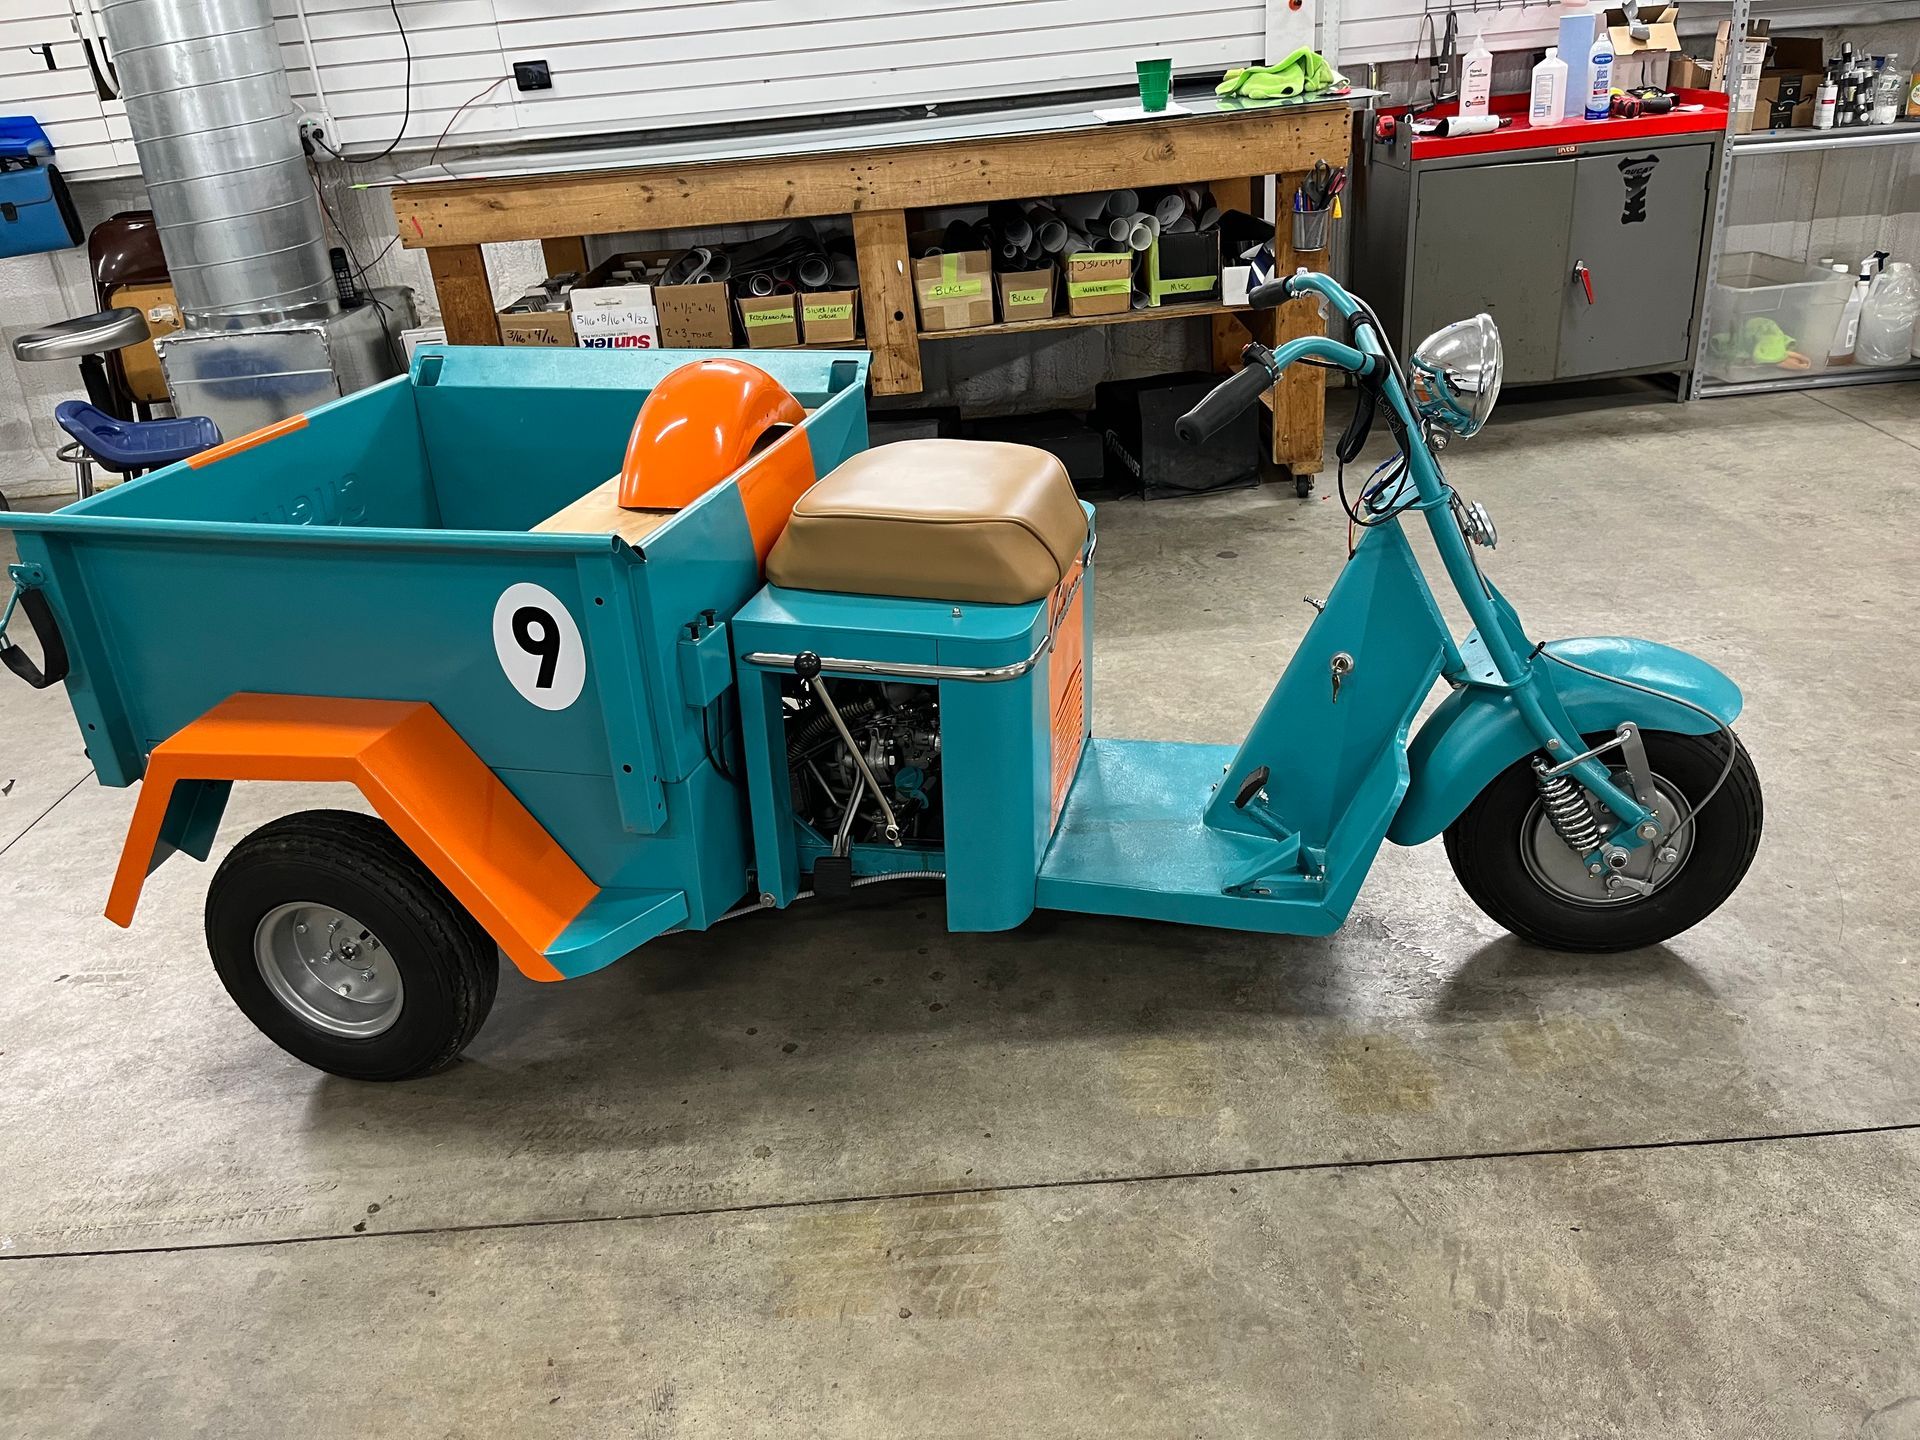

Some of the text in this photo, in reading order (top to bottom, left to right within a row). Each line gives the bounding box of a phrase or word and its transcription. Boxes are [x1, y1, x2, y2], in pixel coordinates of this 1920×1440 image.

[1082, 285, 1108, 293] WHITE
[1170, 283, 1192, 292] MISC
[1011, 293, 1036, 303] BLACK
[576, 314, 596, 326] 5/16
[600, 312, 621, 326] 8/16
[626, 311, 649, 326] 9/32
[506, 329, 526, 344] 3/16
[534, 328, 560, 345] 4/16
[665, 327, 673, 338] 2
[681, 328, 688, 338] 3
[690, 331, 714, 339] TONE
[511, 606, 561, 689] 9
